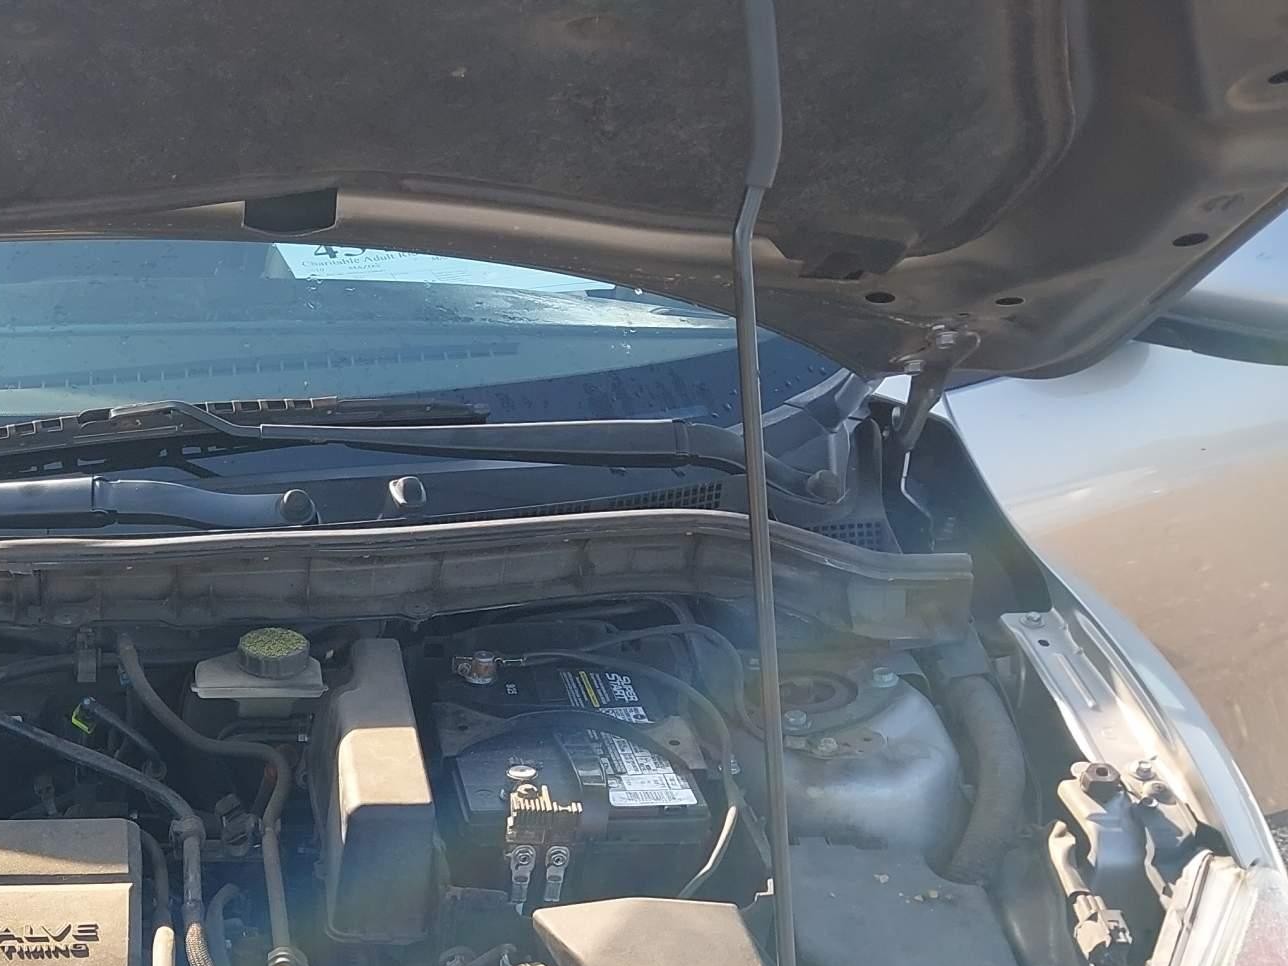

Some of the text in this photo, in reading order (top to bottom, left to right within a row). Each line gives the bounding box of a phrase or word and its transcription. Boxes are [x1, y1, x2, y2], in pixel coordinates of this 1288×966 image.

[302, 257, 360, 267] Charitable
[363, 253, 395, 263] Adult
[605, 672, 627, 702] START
[618, 675, 640, 702] SUPER
[2, 942, 91, 960] TIMING
